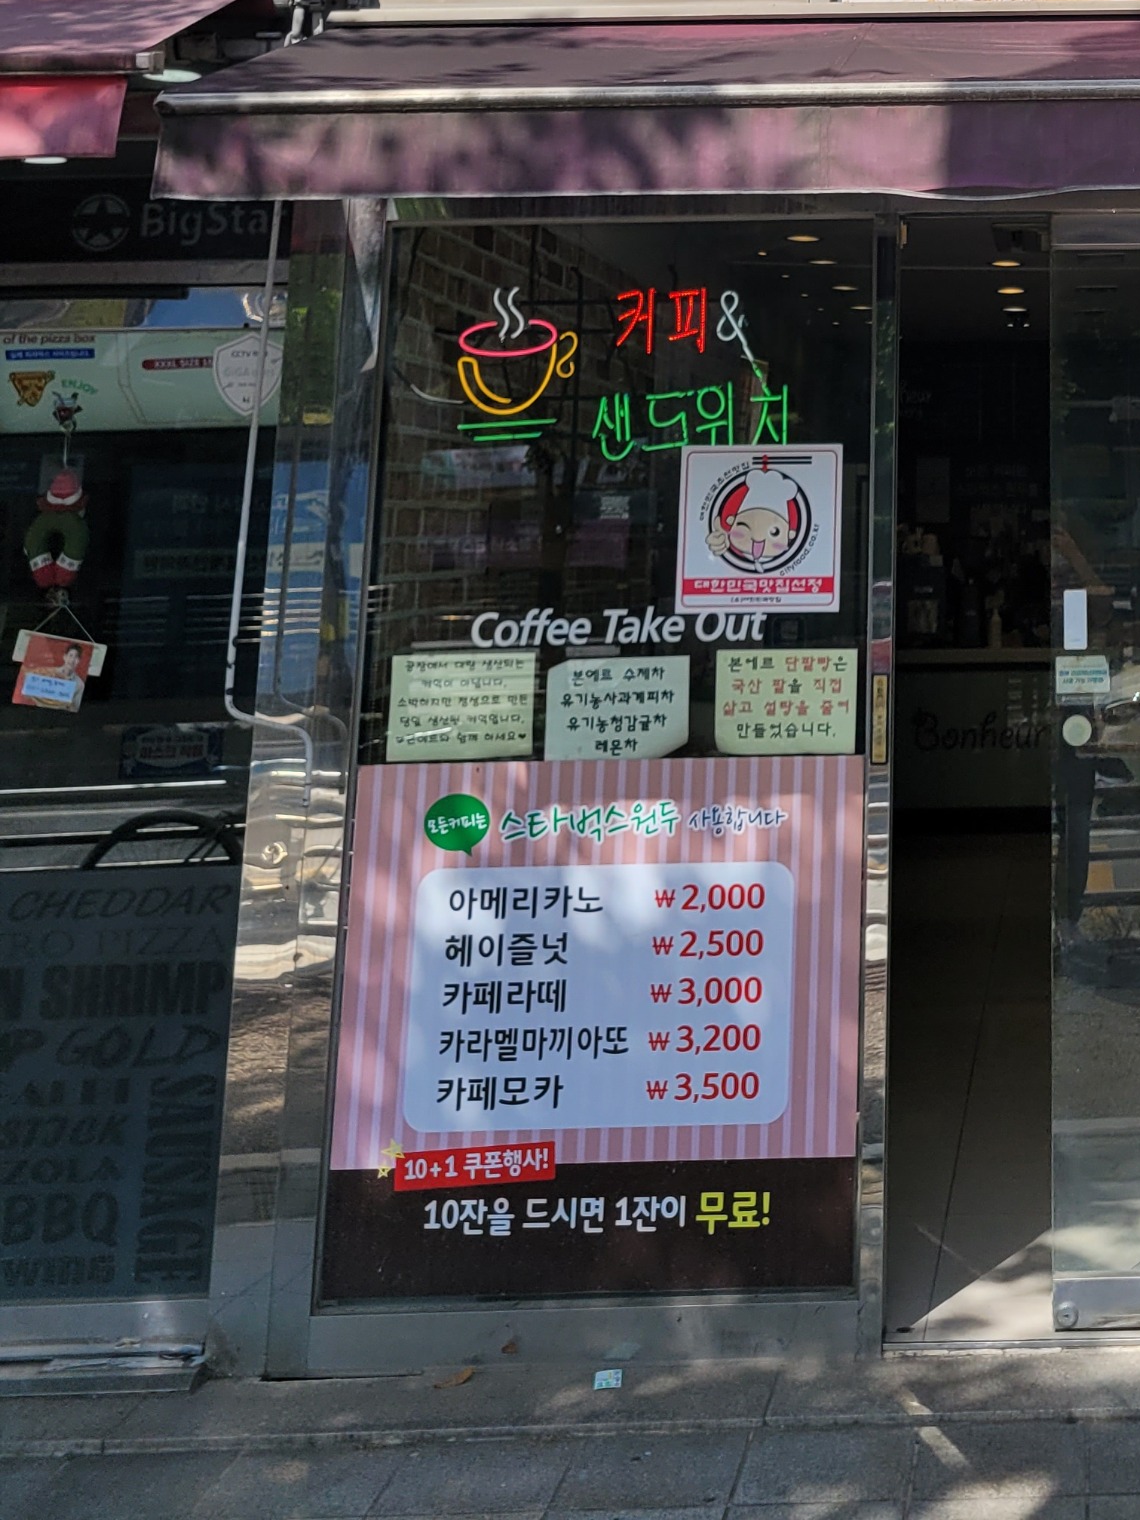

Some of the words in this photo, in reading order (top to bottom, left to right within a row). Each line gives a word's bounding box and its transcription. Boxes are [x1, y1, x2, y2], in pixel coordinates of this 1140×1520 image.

[140, 202, 288, 246] BigSta
[592, 380, 789, 461] 샌드위치
[694, 578, 823, 594] 대한민국맛집선정
[471, 608, 592, 648] Coffee
[602, 609, 685, 645] Take
[695, 610, 767, 644] Out
[427, 812, 487, 835] 모든커피는
[501, 801, 680, 842] 스타벅스원두
[688, 805, 787, 835] 사용합니다
[7, 883, 232, 921] CHEDDAR
[448, 885, 604, 920] 아메리카노
[444, 932, 570, 967] 헤이즐넛
[441, 979, 568, 1014] 카페라떼
[438, 1026, 630, 1063] 카라멜마끼아또
[436, 1075, 564, 1111] 카페모카
[462, 1147, 549, 1180] 쿠폰행사!
[1, 1191, 119, 1247] BBQ
[422, 1197, 516, 1236] 10잔을
[521, 1196, 605, 1234] 드시면
[613, 1194, 687, 1233] 1잔이
[695, 1191, 772, 1236] 무료!
